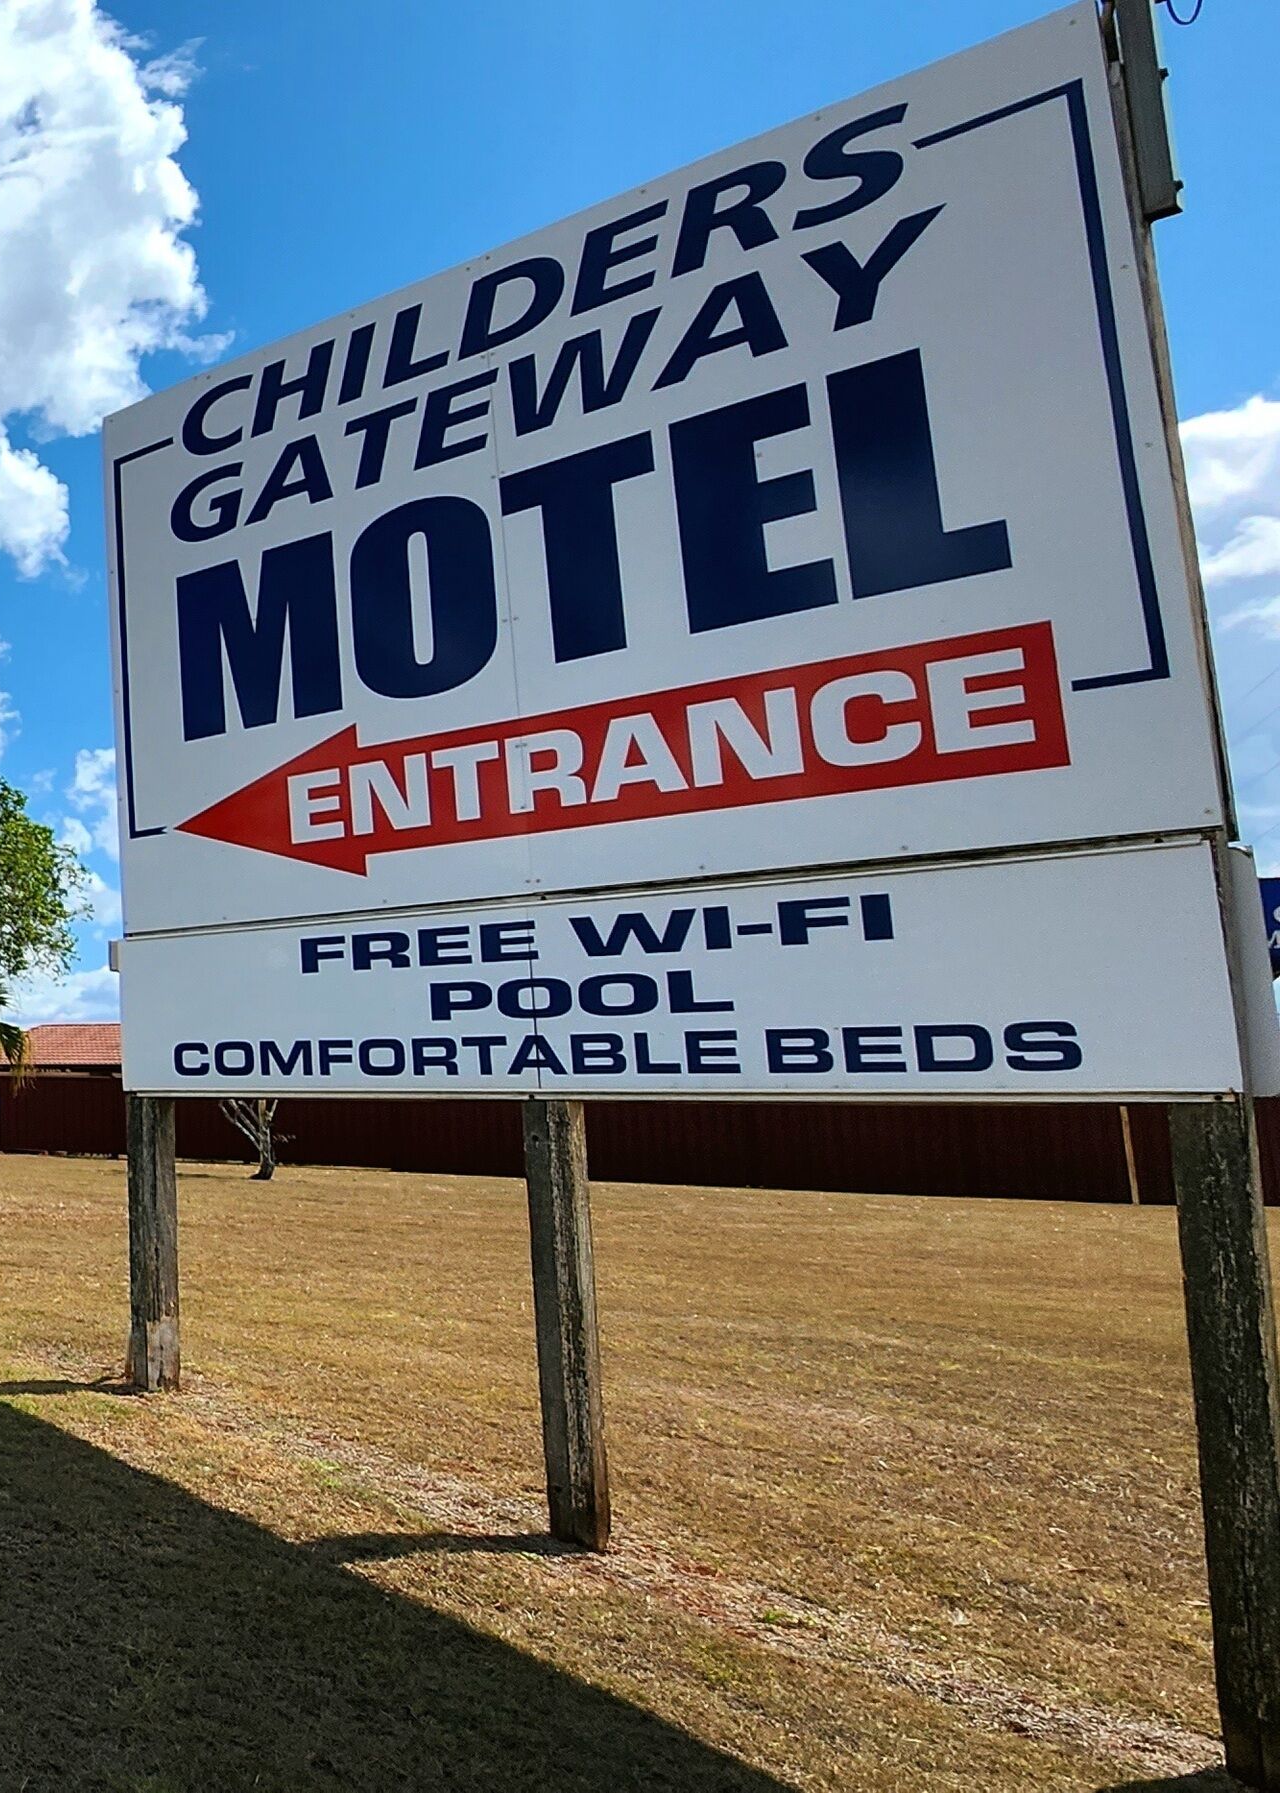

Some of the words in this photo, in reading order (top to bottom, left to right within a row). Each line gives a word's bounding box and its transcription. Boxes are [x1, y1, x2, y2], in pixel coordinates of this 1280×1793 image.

[170, 202, 947, 543] GATEWAY
[182, 102, 909, 456] CHILDERS
[175, 347, 1013, 743] MOTEL
[287, 647, 1036, 846] ENTRANCE
[300, 920, 539, 974] FREE
[568, 893, 895, 957] WI-FI
[429, 970, 735, 1021] POOL
[173, 1030, 742, 1077] COMFORTABLE
[764, 1021, 1083, 1074] BEDS
